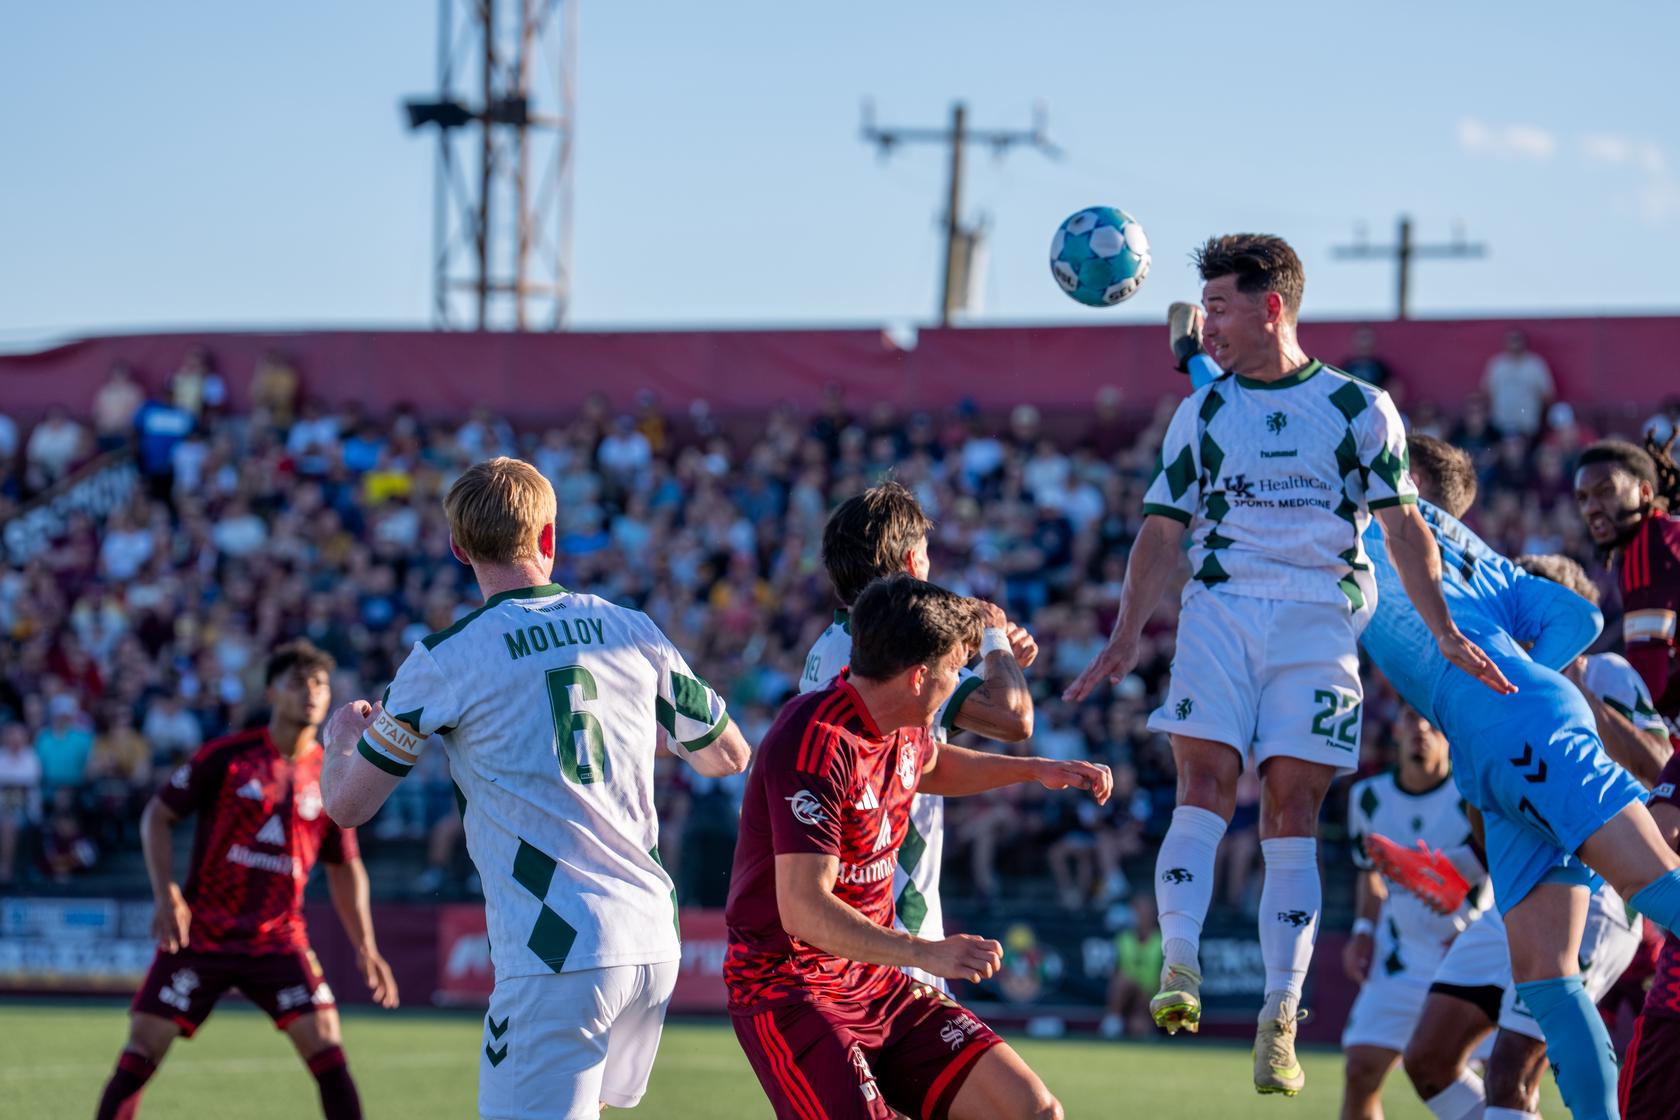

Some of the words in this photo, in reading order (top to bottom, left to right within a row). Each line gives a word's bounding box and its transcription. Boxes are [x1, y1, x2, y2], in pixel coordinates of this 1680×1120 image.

[1260, 448, 1298, 459] hummel
[1233, 499, 1275, 508] SPORTS
[1278, 497, 1331, 510] MEDICINE
[502, 617, 605, 660] MOLLOY
[544, 664, 605, 785] 6
[1311, 688, 1361, 746] 22
